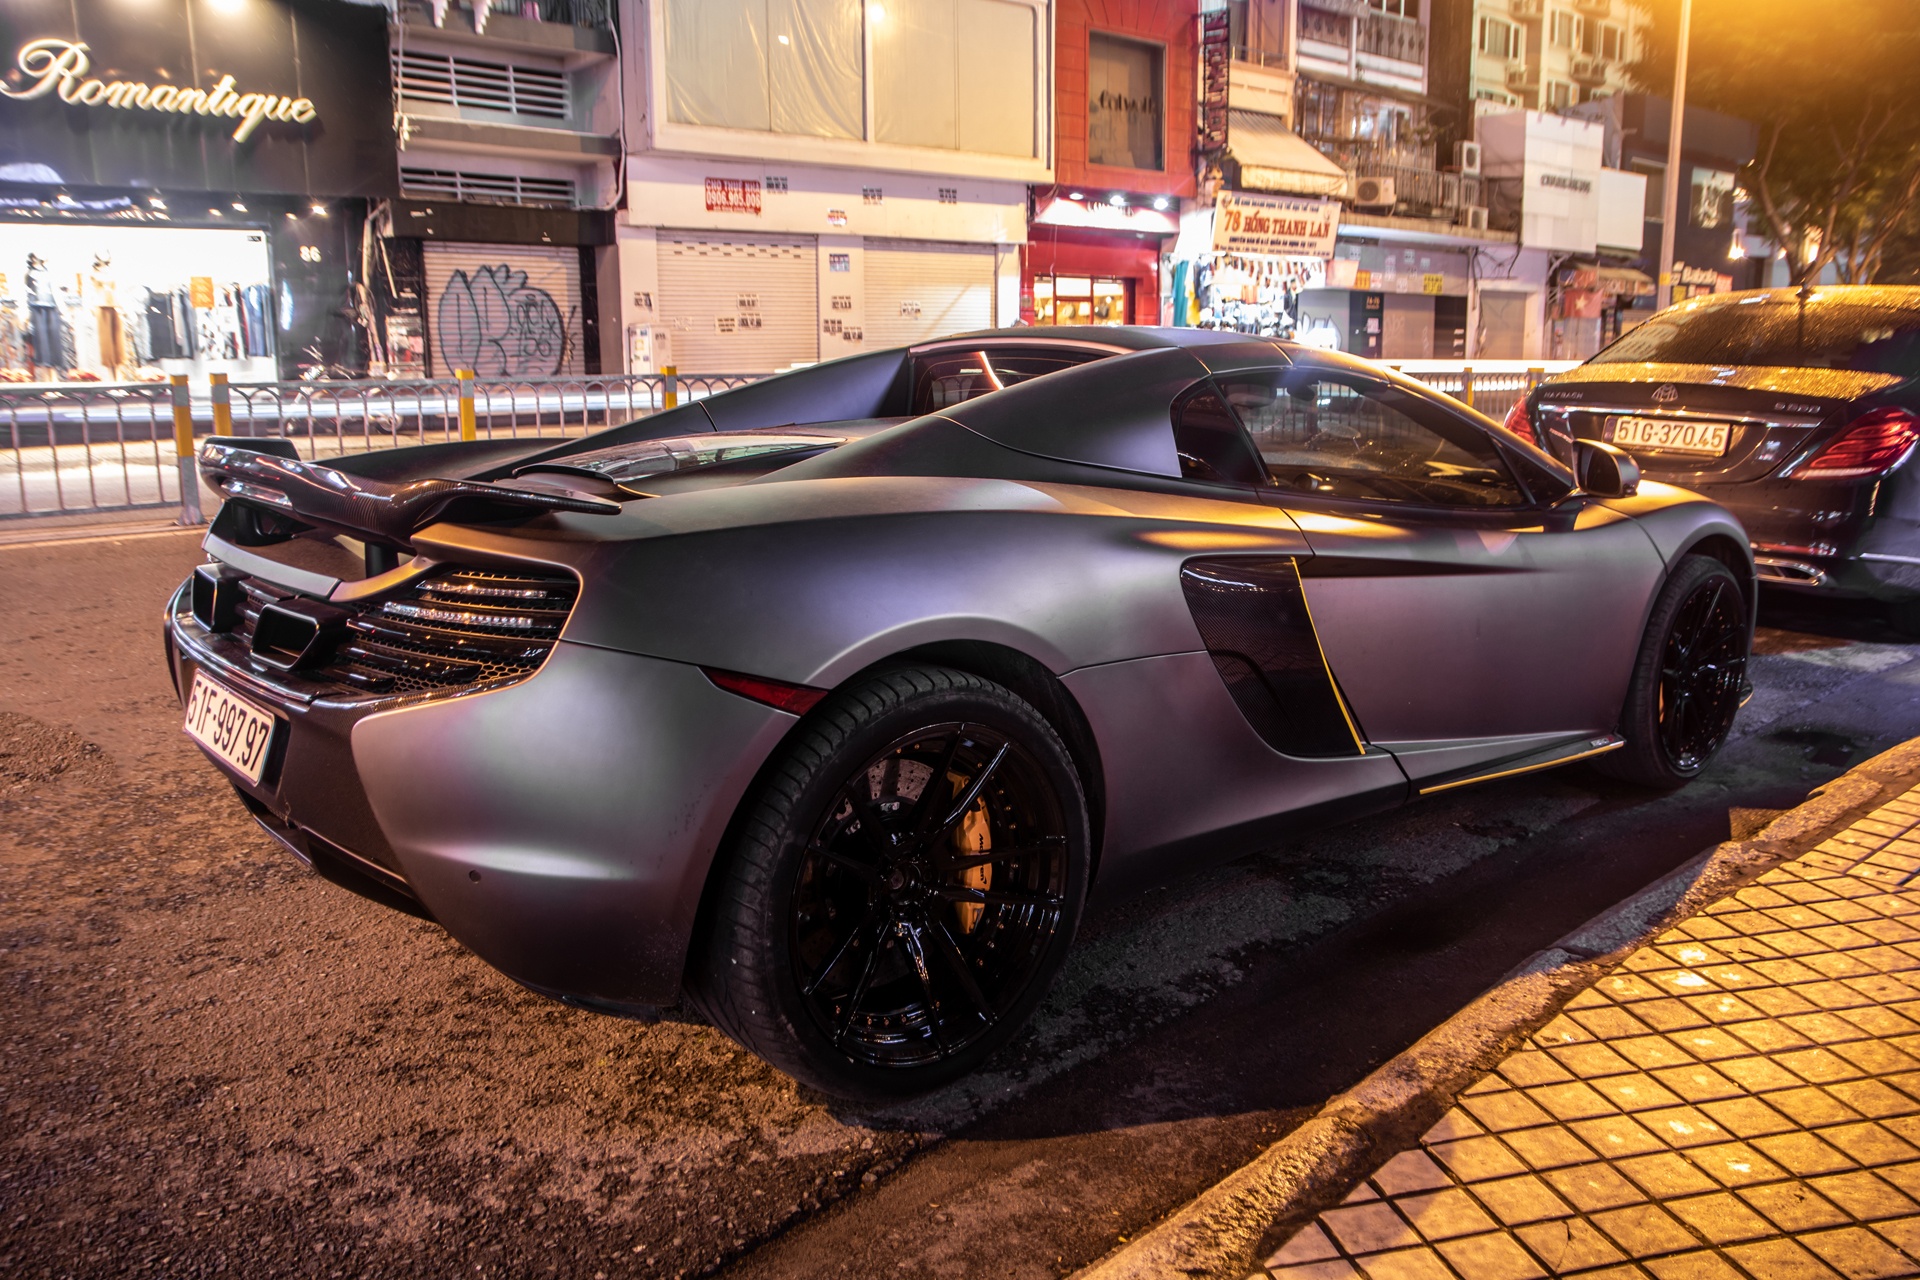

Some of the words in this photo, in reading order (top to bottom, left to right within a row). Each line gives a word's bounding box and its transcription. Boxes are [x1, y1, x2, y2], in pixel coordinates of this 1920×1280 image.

[0, 38, 318, 143] Romantique
[1224, 210, 1241, 232] 78
[1272, 218, 1306, 236] THANH
[1308, 221, 1330, 239] LAN
[299, 244, 322, 263] 86
[1617, 420, 1725, 448] 51G-370.45
[188, 679, 270, 773] 51F-997.97
